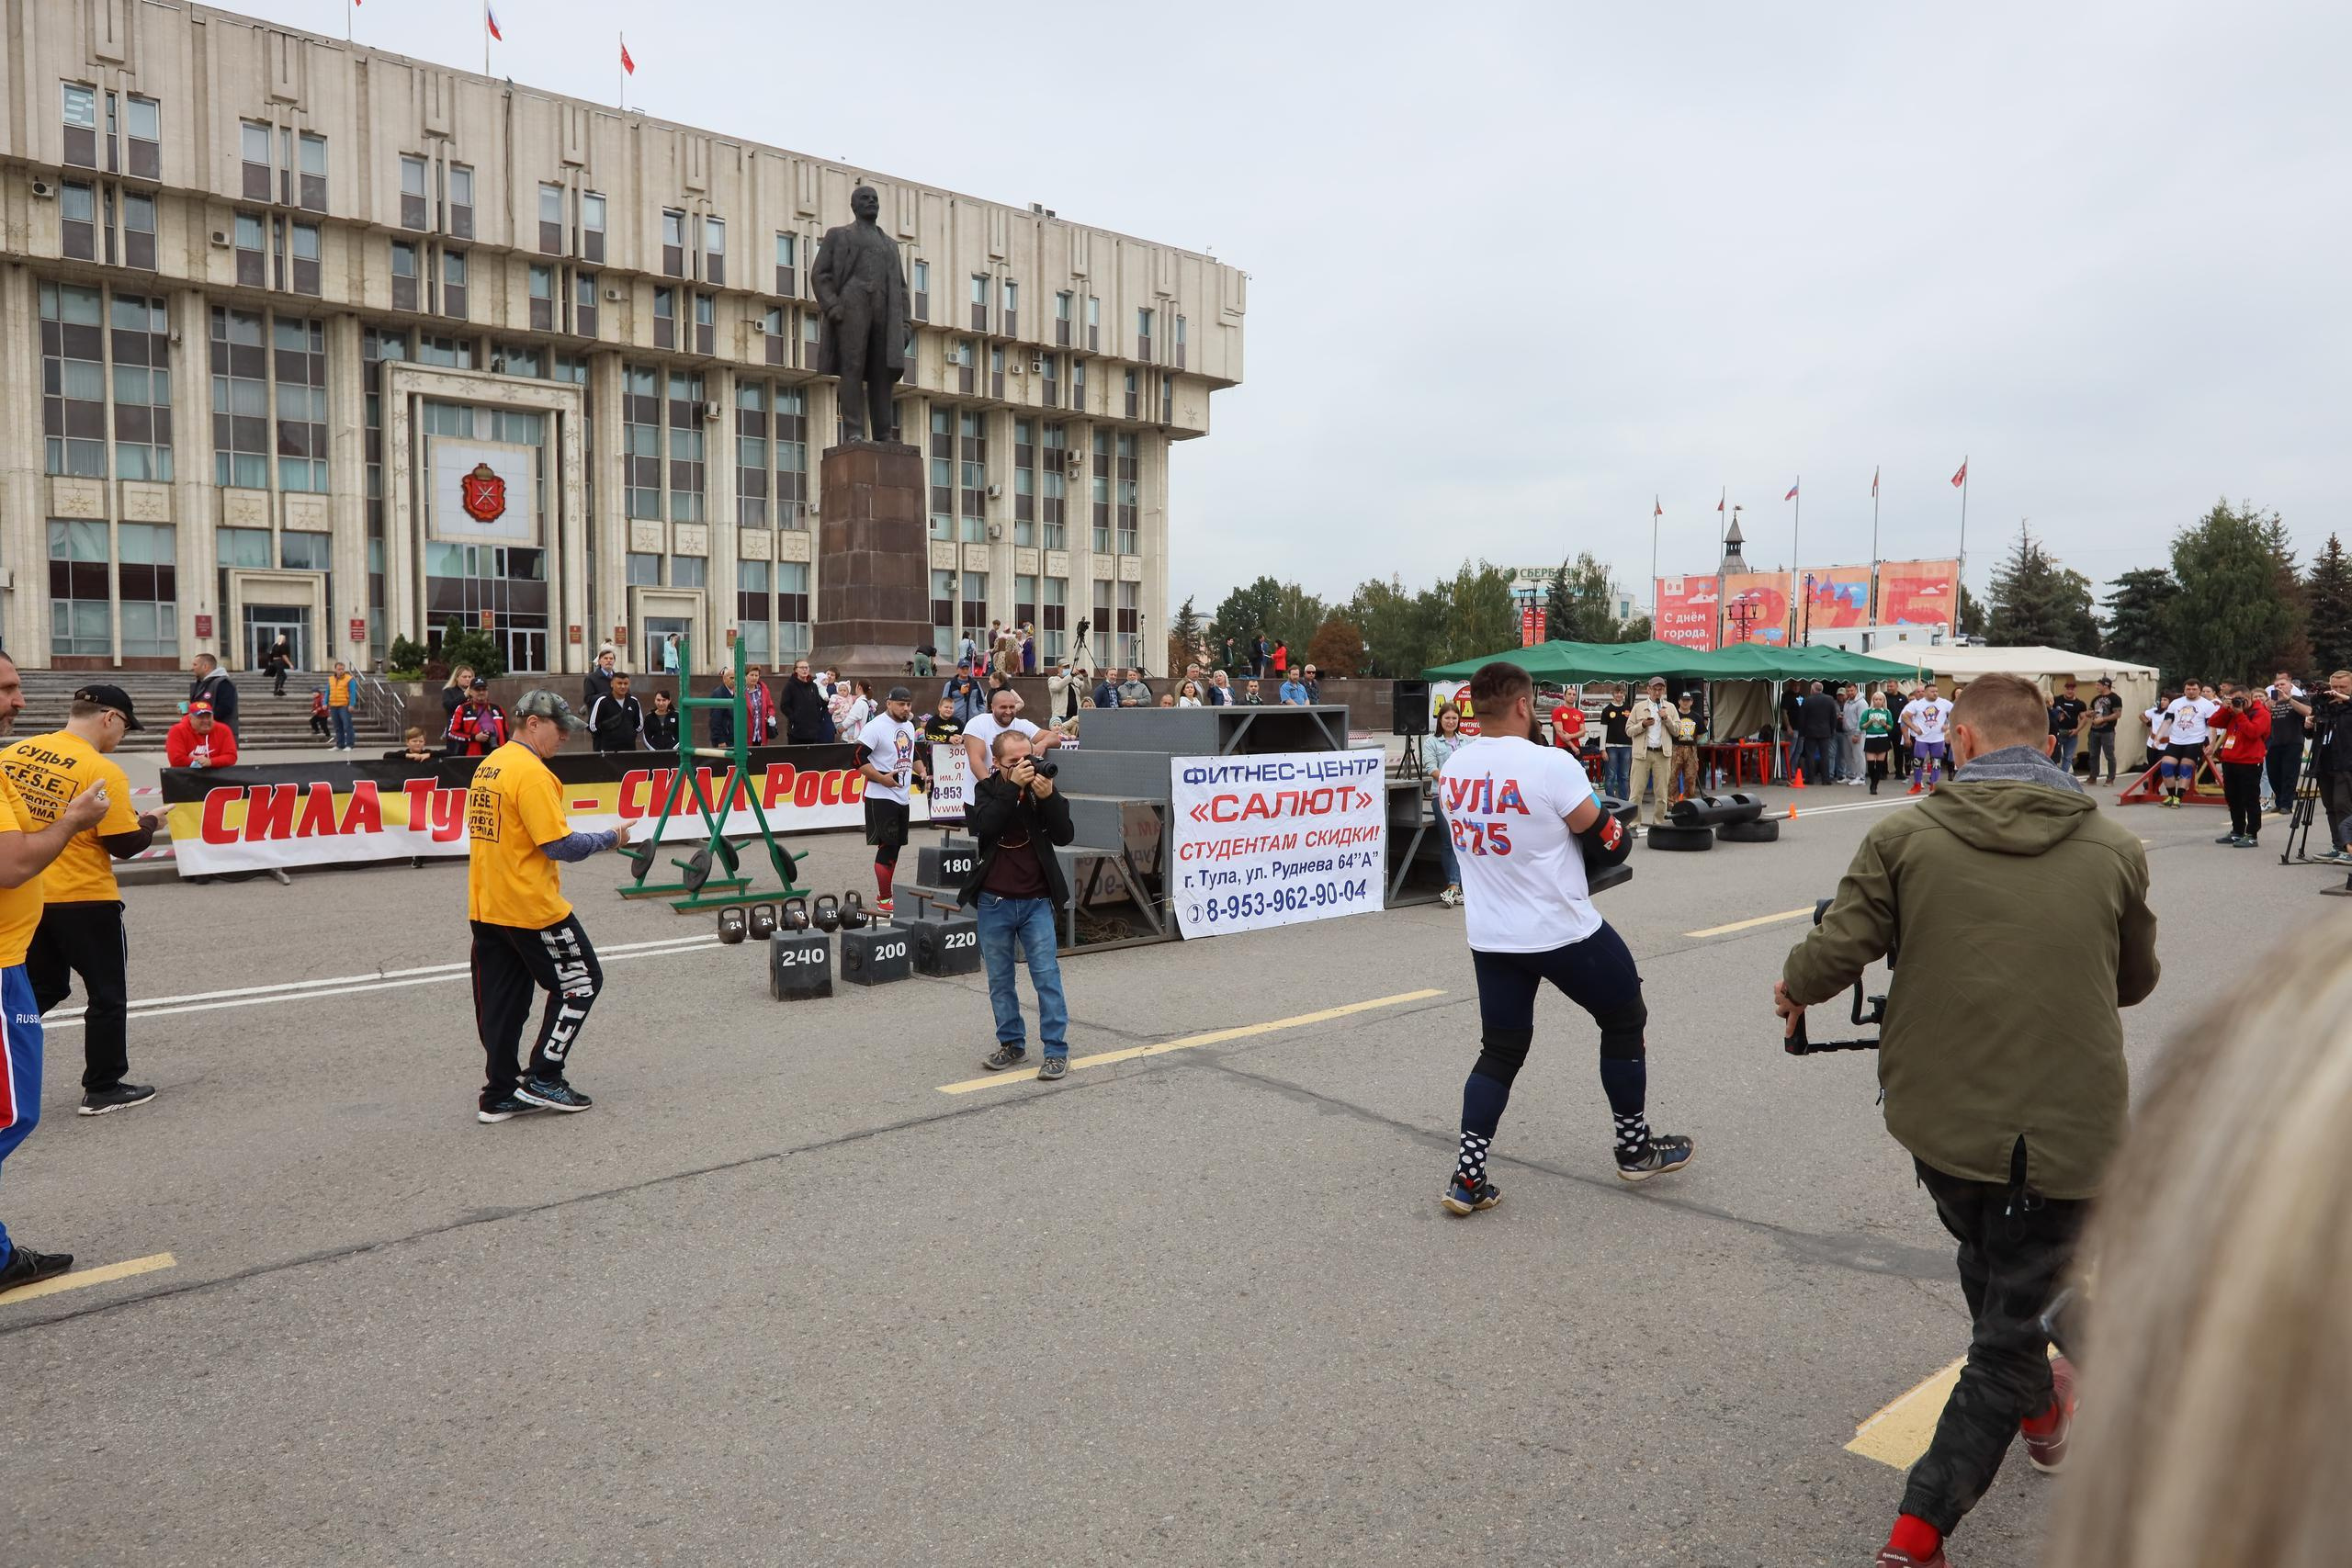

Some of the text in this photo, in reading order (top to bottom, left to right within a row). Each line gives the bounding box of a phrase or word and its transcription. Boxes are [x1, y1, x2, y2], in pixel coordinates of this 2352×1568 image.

[1664, 611, 1706, 623] С днём
[1663, 627, 1709, 640] города,
[17, 745, 77, 770] СУДЬЯ
[474, 766, 501, 780] СУДЬЯ
[1182, 758, 1378, 784] ФИТНЕС-ЦЕНТР
[933, 786, 962, 800] 8-953
[201, 780, 385, 845] СИЛА
[401, 777, 469, 843] Ту
[617, 765, 748, 819] СИЛА
[762, 762, 868, 809] Росс
[1189, 785, 1373, 823] «САЛЮТ»
[1179, 832, 1298, 862] СТУДЕНТАМ
[1305, 825, 1380, 848] СКИДКИ!
[1451, 817, 1512, 856] 875
[943, 858, 972, 874] 180
[1184, 875, 1194, 888] г.
[1198, 869, 1240, 890] Тула,
[1246, 867, 1268, 886] ул.
[1272, 858, 1333, 881] Руднева
[1206, 878, 1366, 922] 8-953-962-90-04
[761, 917, 774, 927] 24
[826, 910, 838, 919] 32
[729, 920, 742, 931] 24
[944, 931, 977, 950] 220
[781, 947, 825, 967] 240
[875, 942, 907, 962] 200
